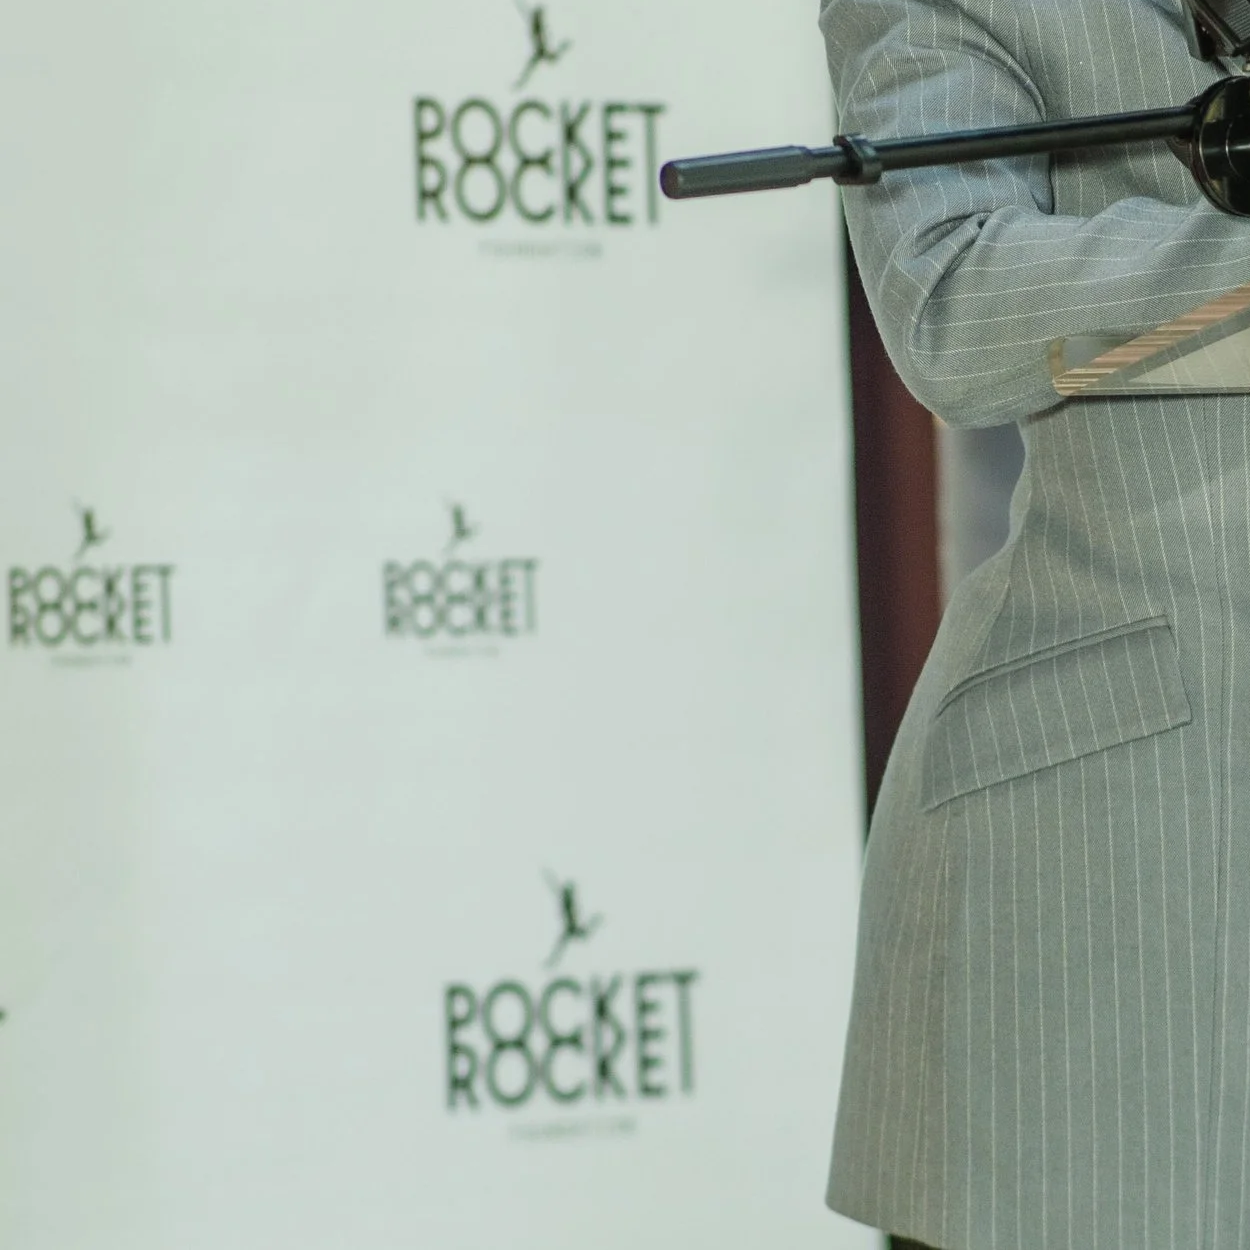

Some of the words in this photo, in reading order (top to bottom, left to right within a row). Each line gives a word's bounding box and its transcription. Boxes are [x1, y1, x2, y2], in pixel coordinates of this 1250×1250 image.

[415, 97, 667, 165] POCKET
[416, 153, 660, 224] ROCKET
[9, 565, 175, 610] POCKET
[384, 556, 541, 603] POCKET
[447, 970, 698, 1046] POCKET
[447, 1036, 694, 1111] ROCKET
